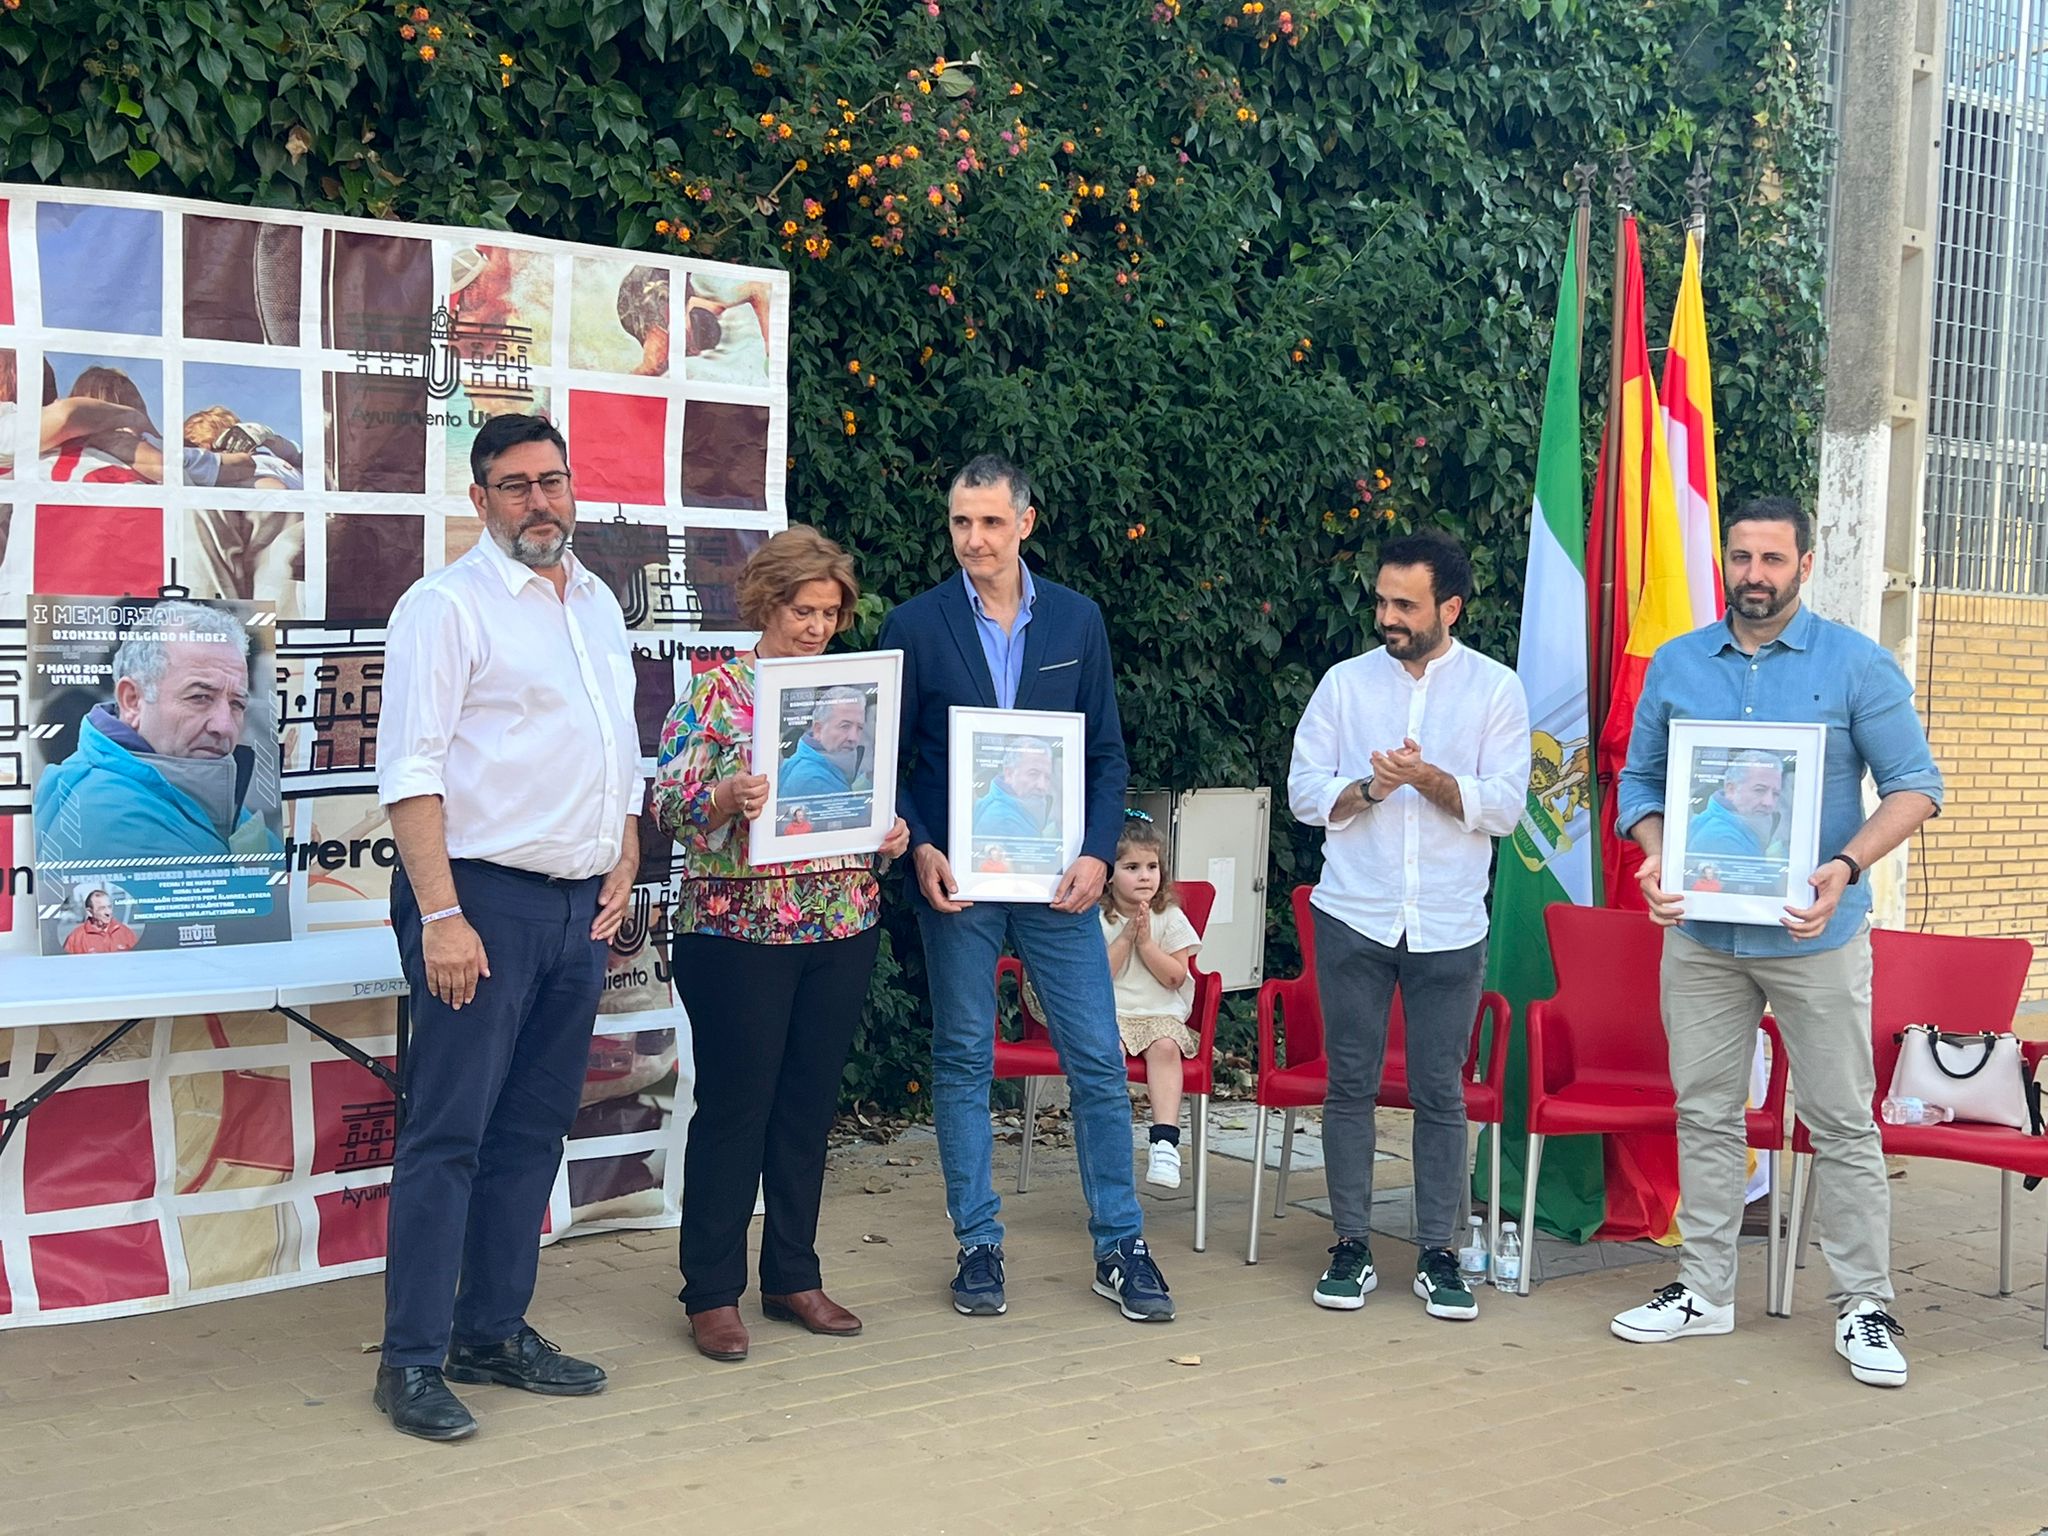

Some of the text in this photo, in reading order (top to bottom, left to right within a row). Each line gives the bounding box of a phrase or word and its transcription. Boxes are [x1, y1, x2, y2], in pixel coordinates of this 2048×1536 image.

[34, 604, 184, 627] I MEMORIAL
[52, 629, 228, 643] DIONISIO DELGADO MÉNDEZ
[658, 640, 735, 661] Utrera
[36, 663, 113, 675] 7 MAYO 2023
[51, 675, 100, 685] UTRERA
[283, 837, 396, 873] trera
